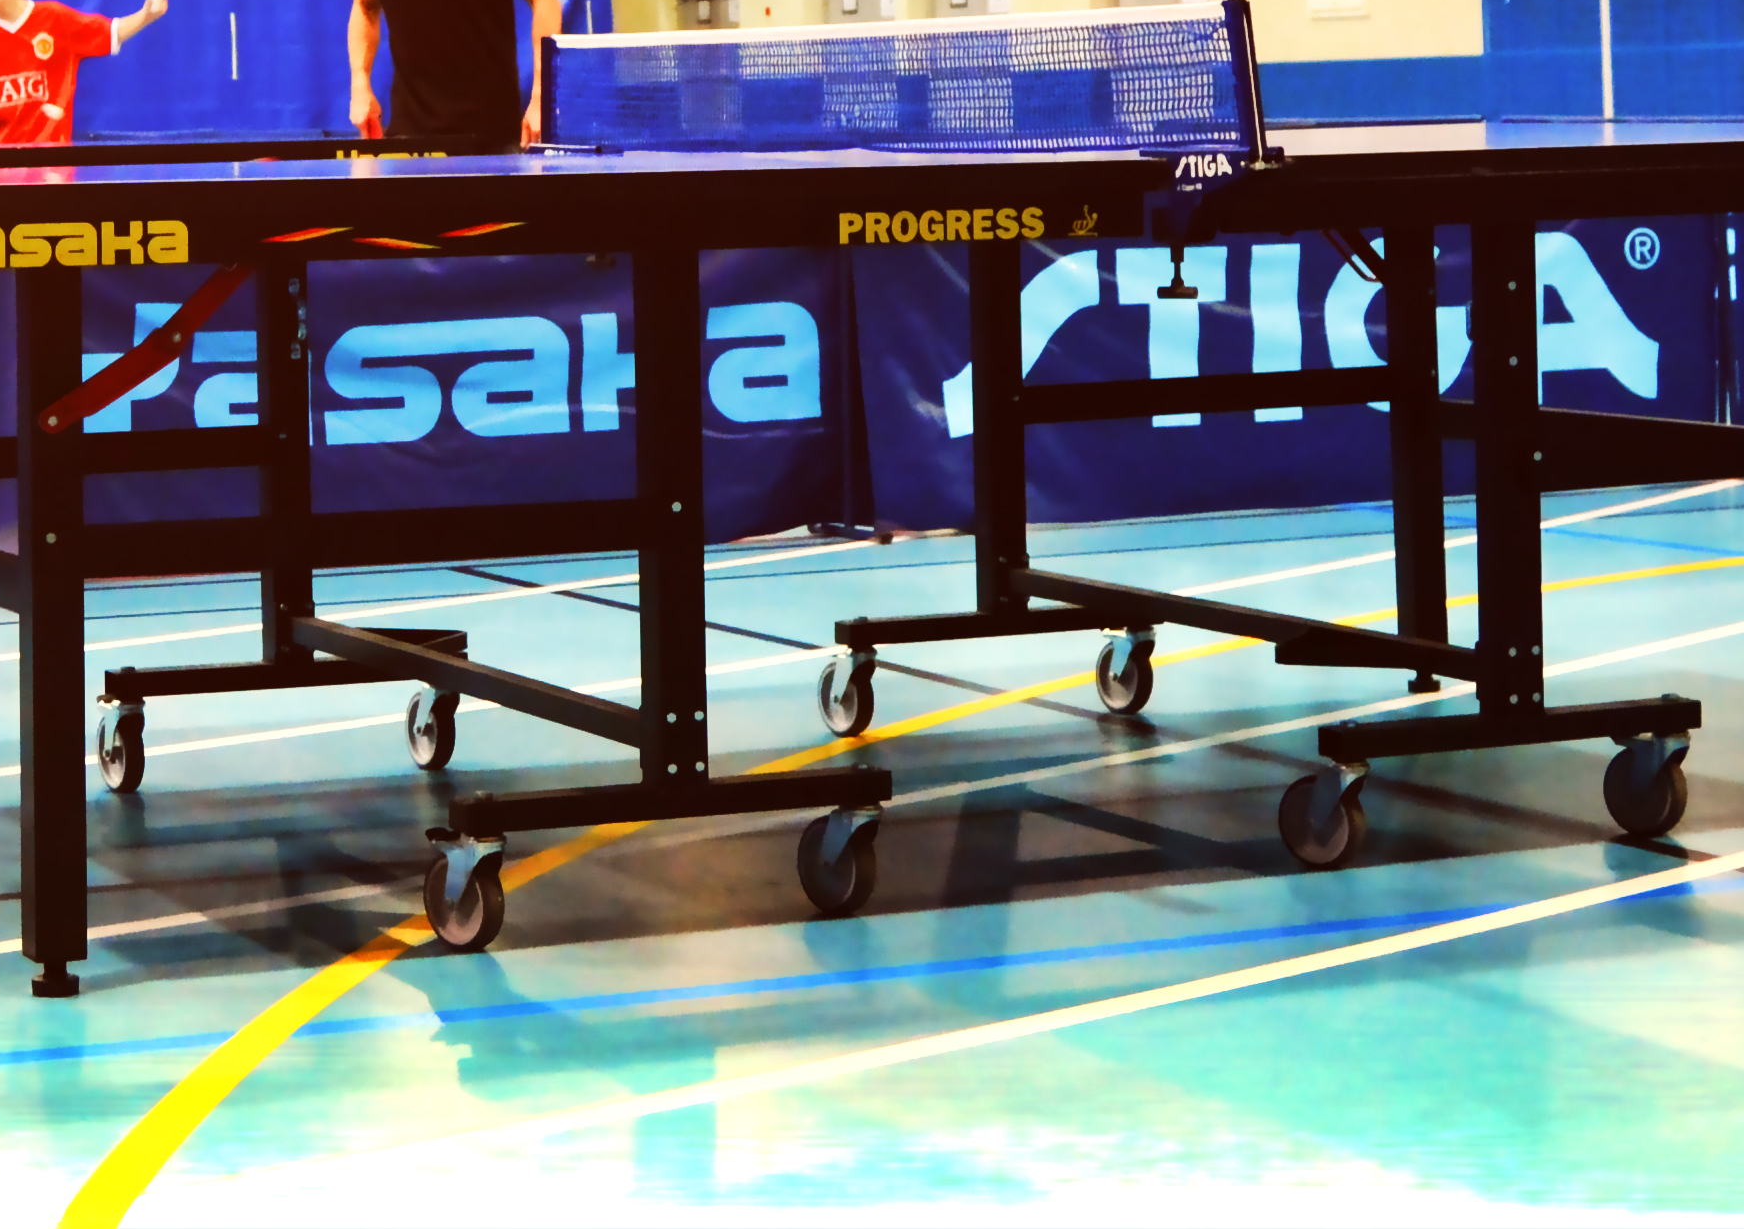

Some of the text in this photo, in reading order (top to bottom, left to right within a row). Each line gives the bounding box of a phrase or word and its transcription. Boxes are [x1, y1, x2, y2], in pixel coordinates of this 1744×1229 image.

[0, 76, 45, 103] AIG
[1175, 153, 1233, 179] STIGA
[838, 206, 1045, 245] PROGRESS
